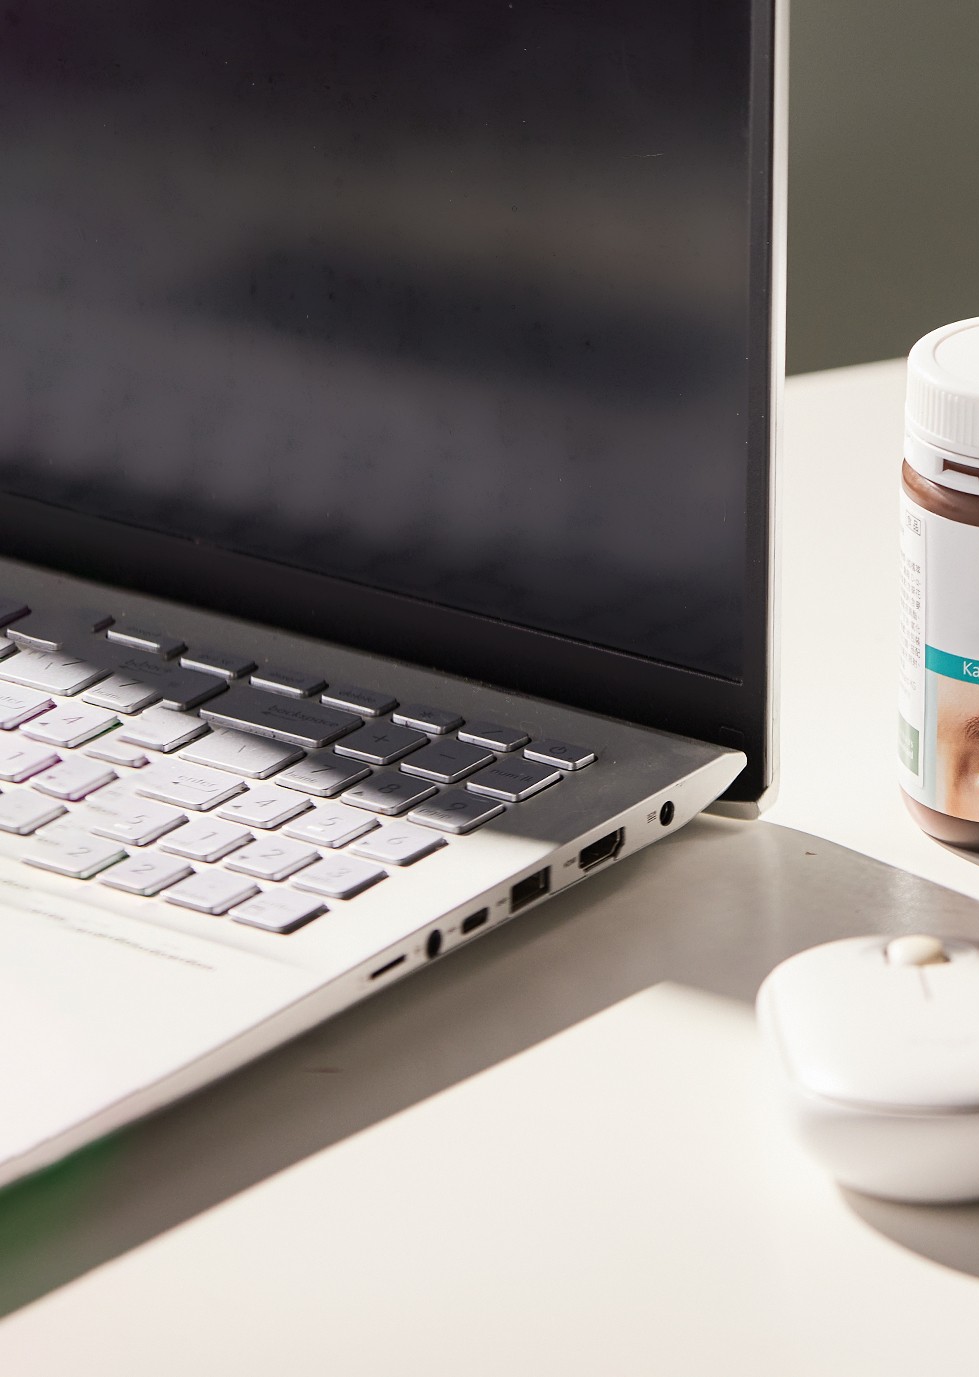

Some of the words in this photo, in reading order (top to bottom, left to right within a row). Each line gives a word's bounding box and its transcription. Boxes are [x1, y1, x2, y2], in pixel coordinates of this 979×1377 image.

[310, 764, 338, 774] 7
[377, 782, 400, 795] 8
[255, 798, 278, 808] 4
[443, 801, 468, 812] 9
[325, 815, 344, 827] 5
[199, 830, 219, 841] 1
[386, 835, 409, 846] 6
[261, 848, 285, 859] 2
